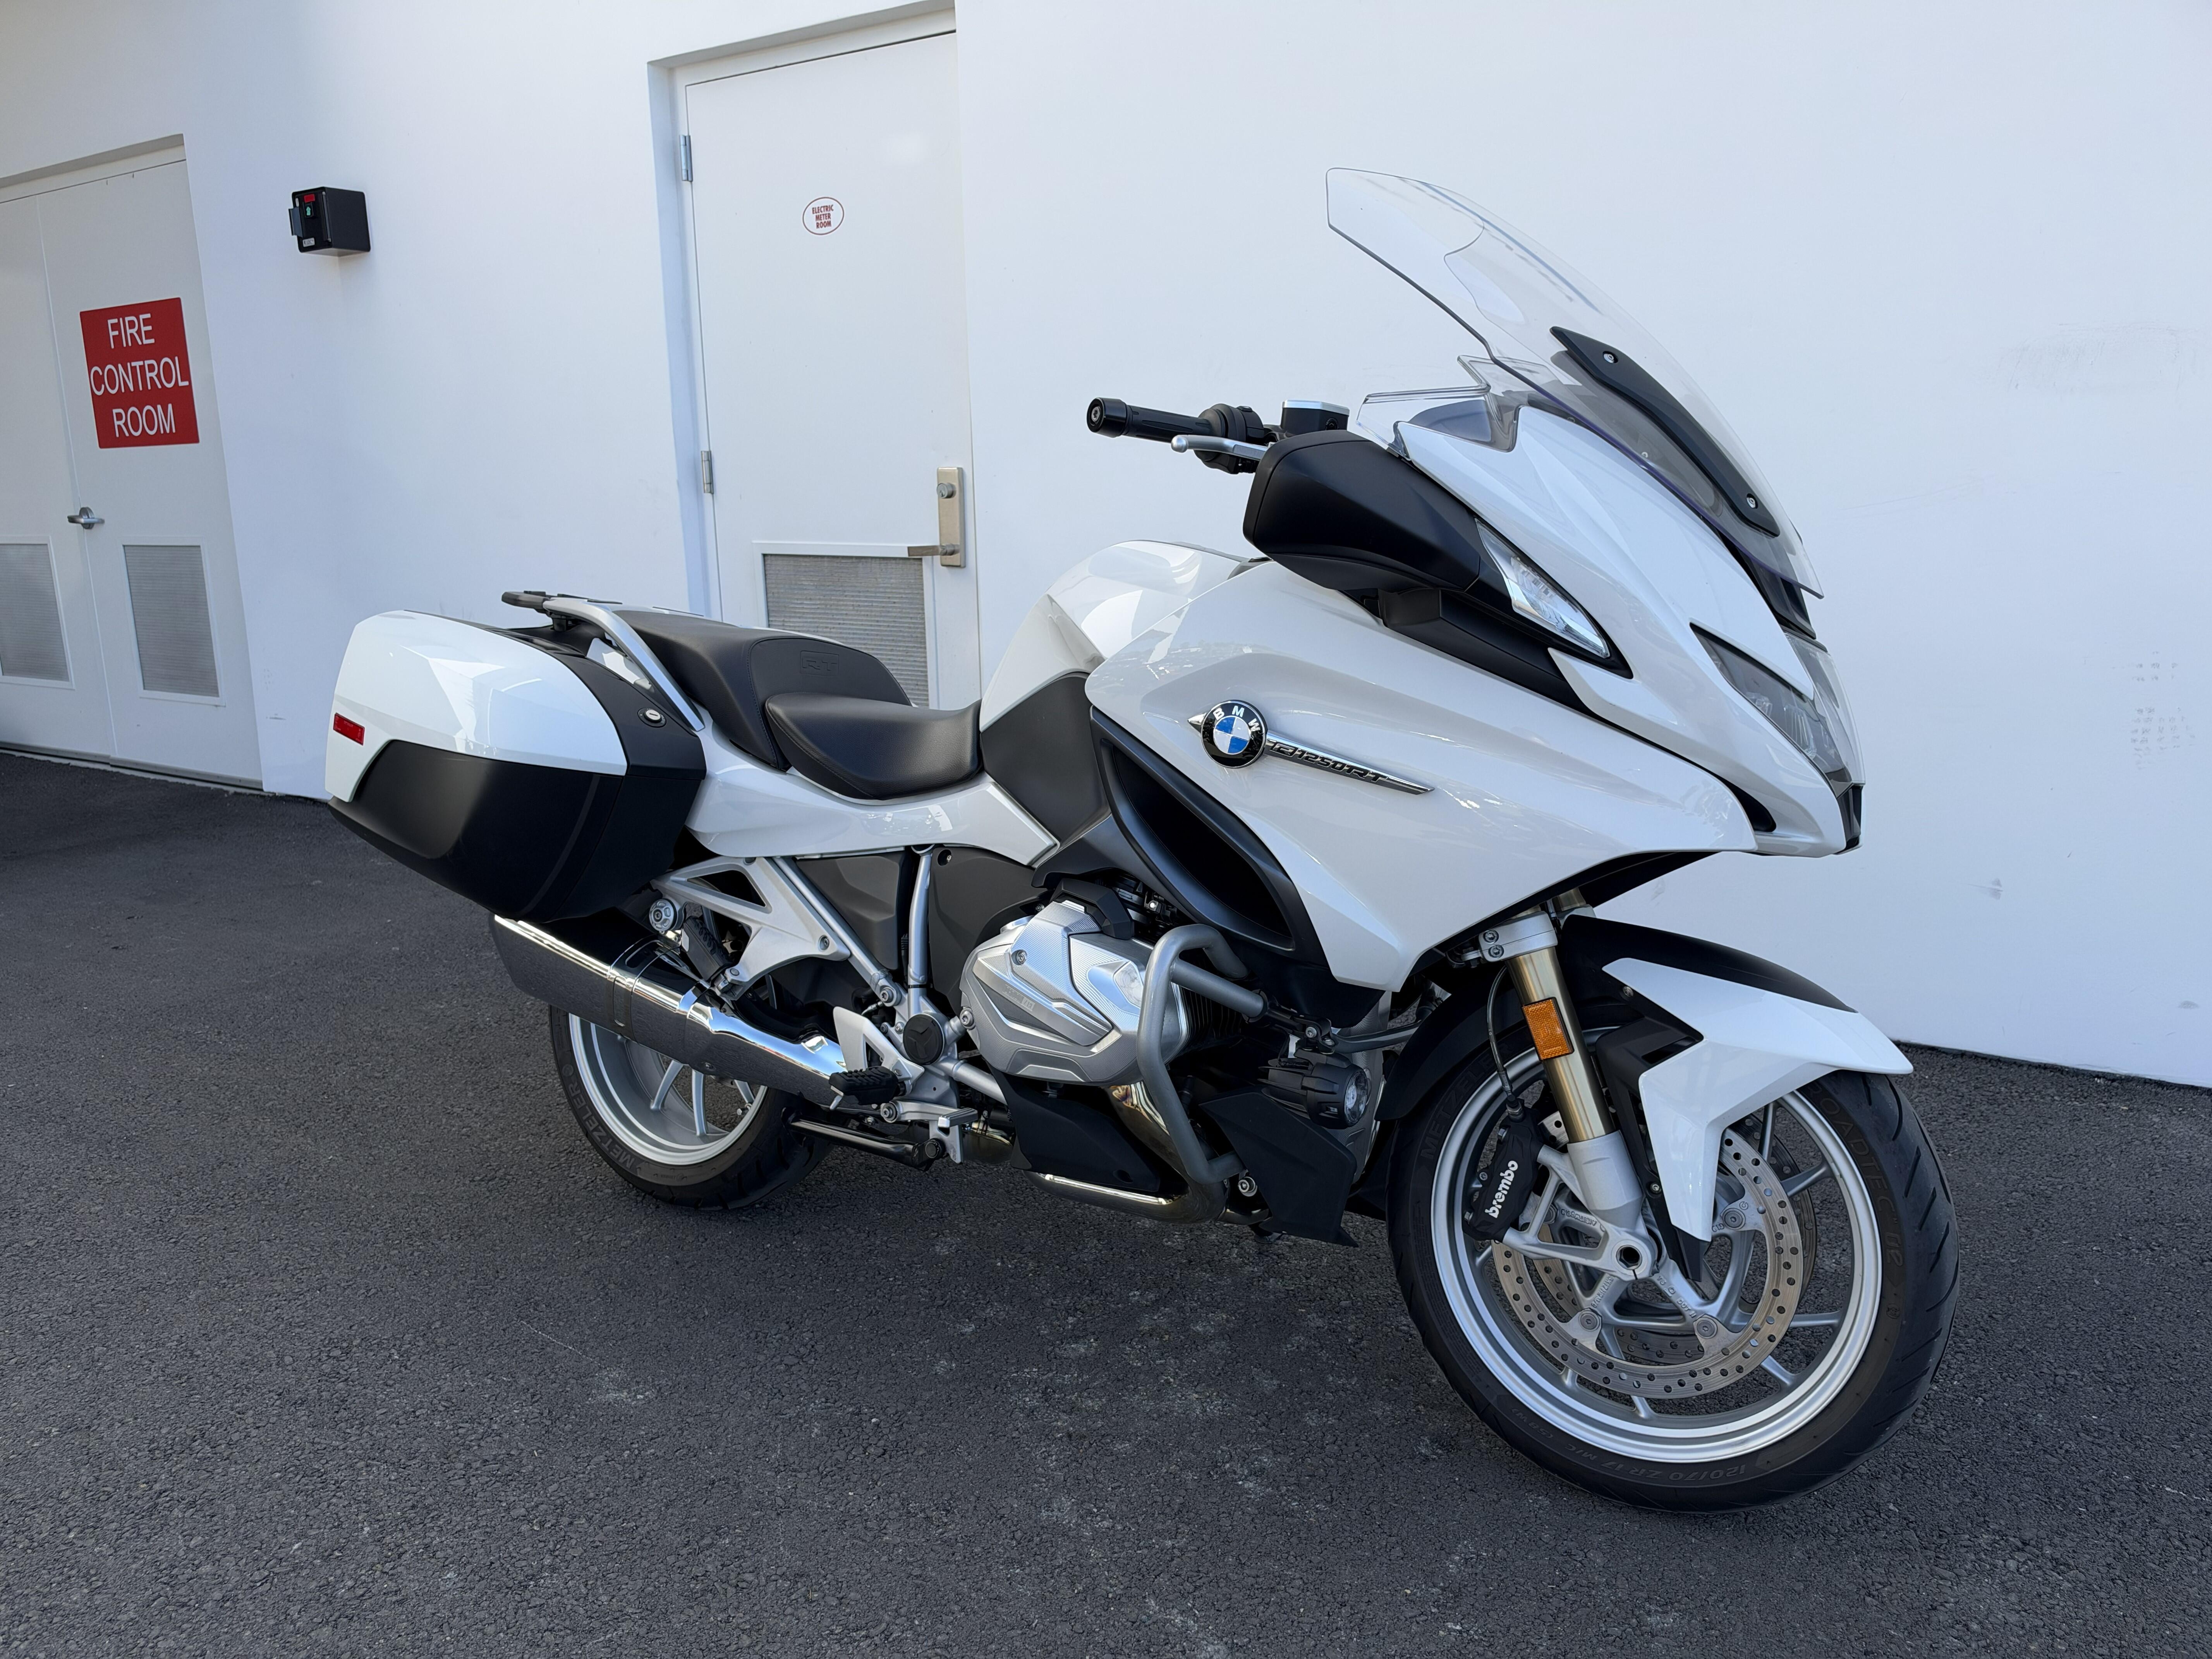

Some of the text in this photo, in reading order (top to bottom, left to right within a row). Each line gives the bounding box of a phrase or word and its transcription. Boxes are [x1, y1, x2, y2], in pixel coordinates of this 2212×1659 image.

[812, 204, 834, 214] ELECTRIC
[816, 213, 831, 221] METER
[816, 220, 831, 228] ROOM
[108, 313, 155, 349] FIRE
[90, 356, 189, 396] CONTROL
[113, 403, 176, 438] ROOM
[802, 656, 838, 672] RT
[1213, 705, 1261, 733] BMW
[568, 1080, 637, 1170] METZELER
[1484, 1160, 1518, 1219] brembo
[1565, 1443, 1598, 1460] M/C
[1601, 1462, 1625, 1472] 17
[1629, 1467, 1665, 1479] ZR
[1668, 1464, 1746, 1481] 120/70
